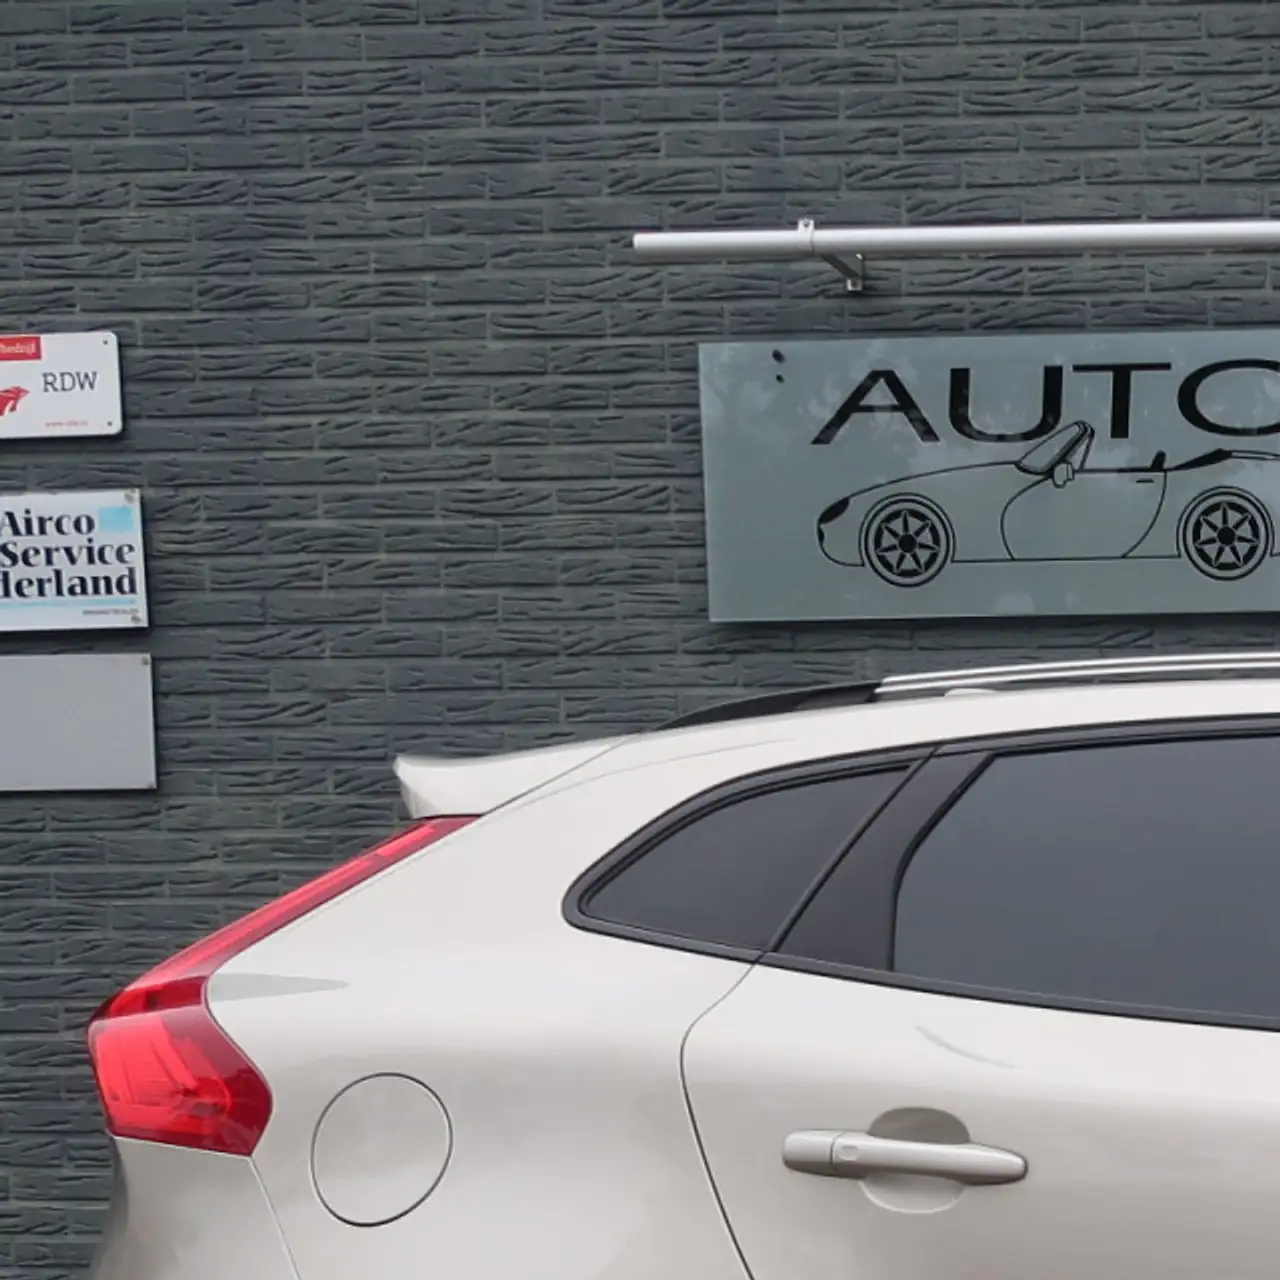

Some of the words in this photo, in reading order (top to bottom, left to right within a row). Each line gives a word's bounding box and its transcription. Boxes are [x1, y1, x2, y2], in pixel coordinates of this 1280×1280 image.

[42, 371, 97, 392] RDW
[0, 508, 95, 536] Airco
[0, 537, 135, 568] Service
